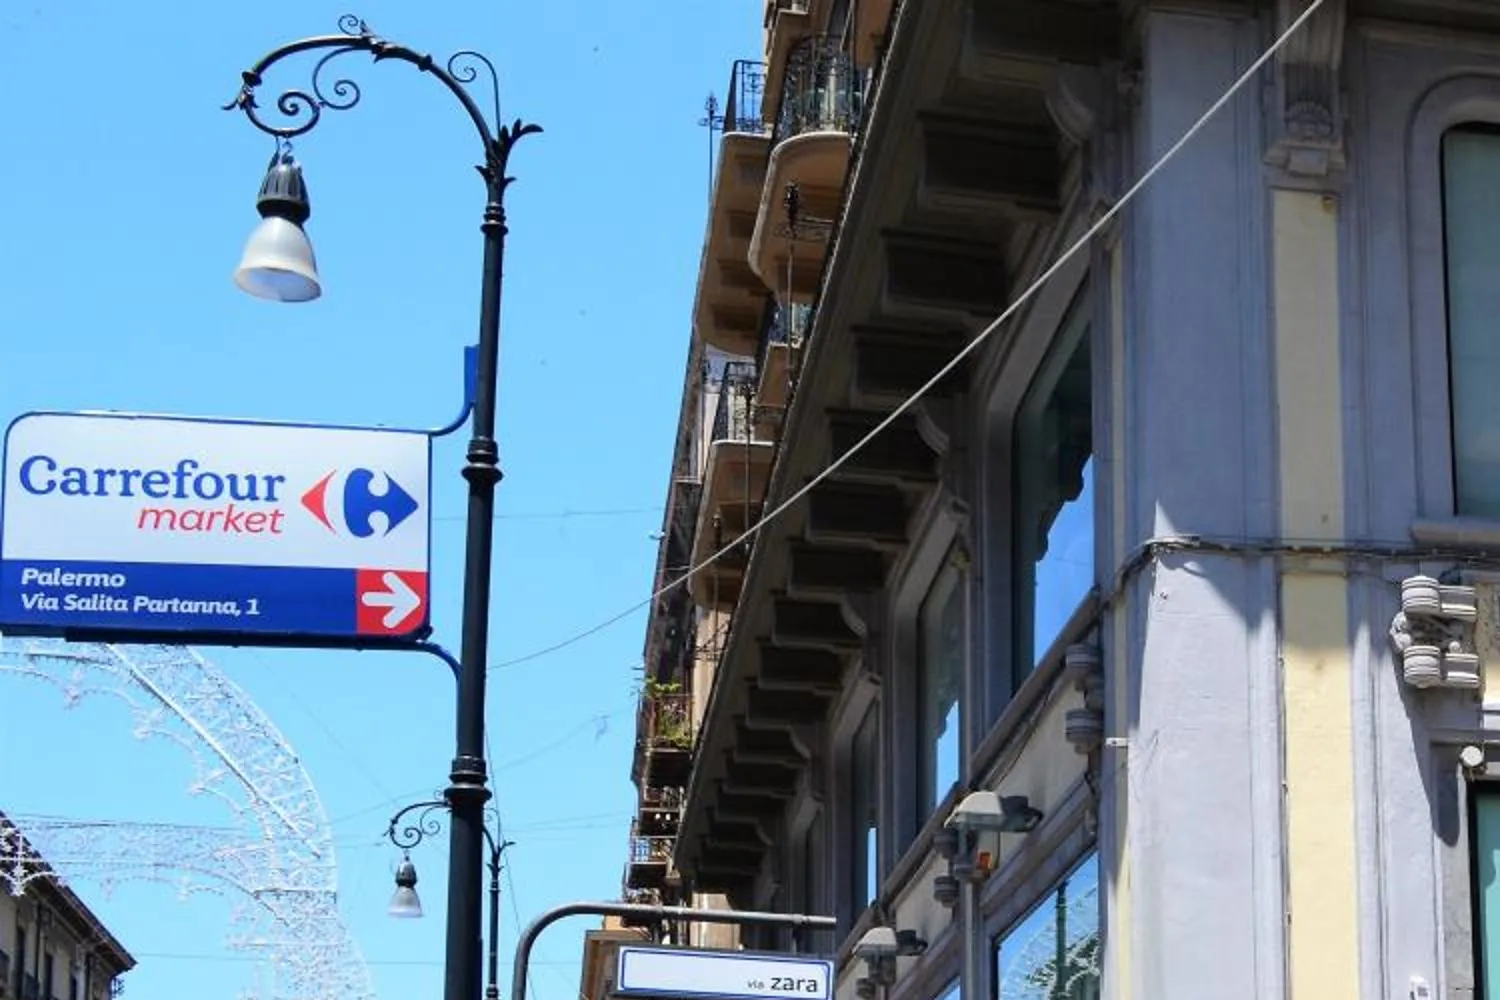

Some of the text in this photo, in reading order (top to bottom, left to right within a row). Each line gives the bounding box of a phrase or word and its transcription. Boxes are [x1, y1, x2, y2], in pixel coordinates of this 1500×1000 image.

[19, 455, 286, 502] Carrefour
[137, 504, 286, 534] market
[21, 567, 126, 588] Palermo
[21, 592, 260, 617] Via Salita Partanna, 1
[771, 977, 818, 992] zara
